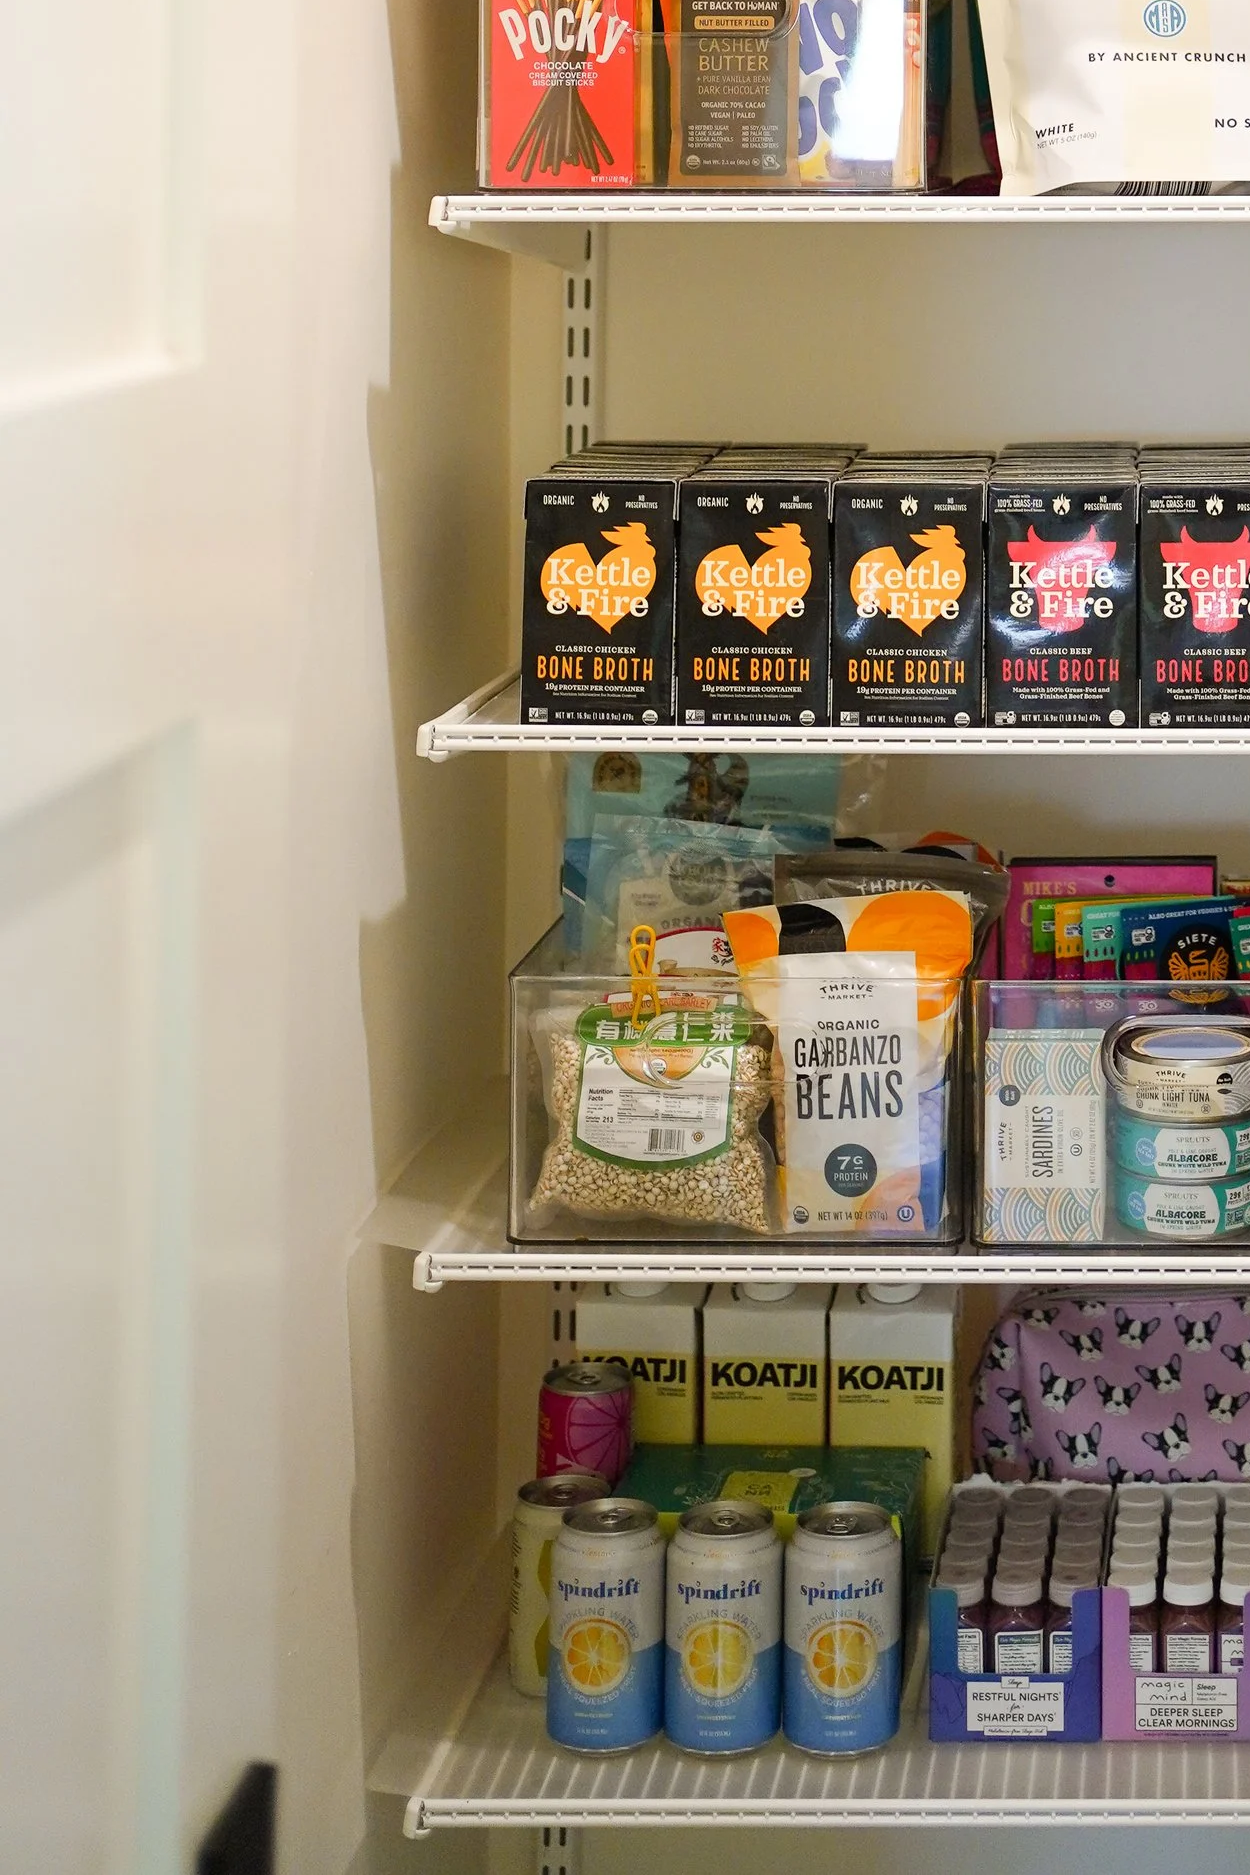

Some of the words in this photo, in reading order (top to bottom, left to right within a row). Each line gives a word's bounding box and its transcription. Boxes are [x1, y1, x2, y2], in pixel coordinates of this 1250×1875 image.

[699, 38, 768, 52] CASHEW
[700, 55, 768, 71] BUTTER
[1088, 53, 1105, 62] BY
[1113, 53, 1177, 62] ANCIENT
[1184, 53, 1246, 62] CRUNCH
[534, 62, 593, 70] CHOCOLATE
[698, 86, 720, 94] DARK
[723, 86, 770, 94] CHOCOLATE
[1035, 123, 1074, 139] WHITE
[1215, 119, 1237, 128] NO
[625, 501, 658, 509] PRESERVATIVES
[548, 557, 651, 587] Kettle
[701, 558, 805, 587] Kettle
[856, 560, 960, 590] Kettle
[1009, 560, 1114, 590] Kettle
[547, 588, 571, 615] &
[577, 588, 649, 617] Fire
[701, 589, 725, 617] &
[732, 590, 805, 618] Fire
[857, 591, 880, 618] &
[887, 591, 959, 619] Fire
[555, 645, 593, 653] CLASSIC
[595, 646, 636, 654] CHICKEN
[1184, 648, 1222, 656] CLASSIC
[537, 655, 583, 680] BONE
[594, 656, 653, 681] BROTH
[693, 657, 739, 681] BONE
[751, 658, 810, 682] BROTH
[848, 659, 894, 683] BONE
[906, 660, 965, 684] BROTH
[1023, 881, 1077, 896] MIKE'S
[1177, 934, 1218, 949] SIETE
[794, 1034, 901, 1068] GARBANZO
[796, 1070, 903, 1120] BEANS
[1032, 1106, 1053, 1177] SARDINES
[1167, 1153, 1218, 1162] ALBACORE
[833, 1172, 868, 1181] PROTEIN
[1156, 1210, 1206, 1219] ALBACORE
[711, 1362, 818, 1388] KOATJI
[838, 1365, 944, 1391] KOATJI
[558, 1578, 641, 1602] spindrift
[677, 1579, 762, 1604] spindrift
[1141, 1682, 1184, 1692] magic
[973, 1693, 1015, 1701] RESTFUL
[1020, 1692, 1059, 1701] NIGHTS
[1150, 1693, 1187, 1702] mind
[977, 1713, 1024, 1722] SHARPER
[1028, 1713, 1054, 1722] DAYS
[1150, 1708, 1190, 1717] DEEPER
[1192, 1709, 1223, 1717] SLEEP
[1138, 1719, 1173, 1728] CLEAR
[1175, 1719, 1234, 1728] MORNINGS
